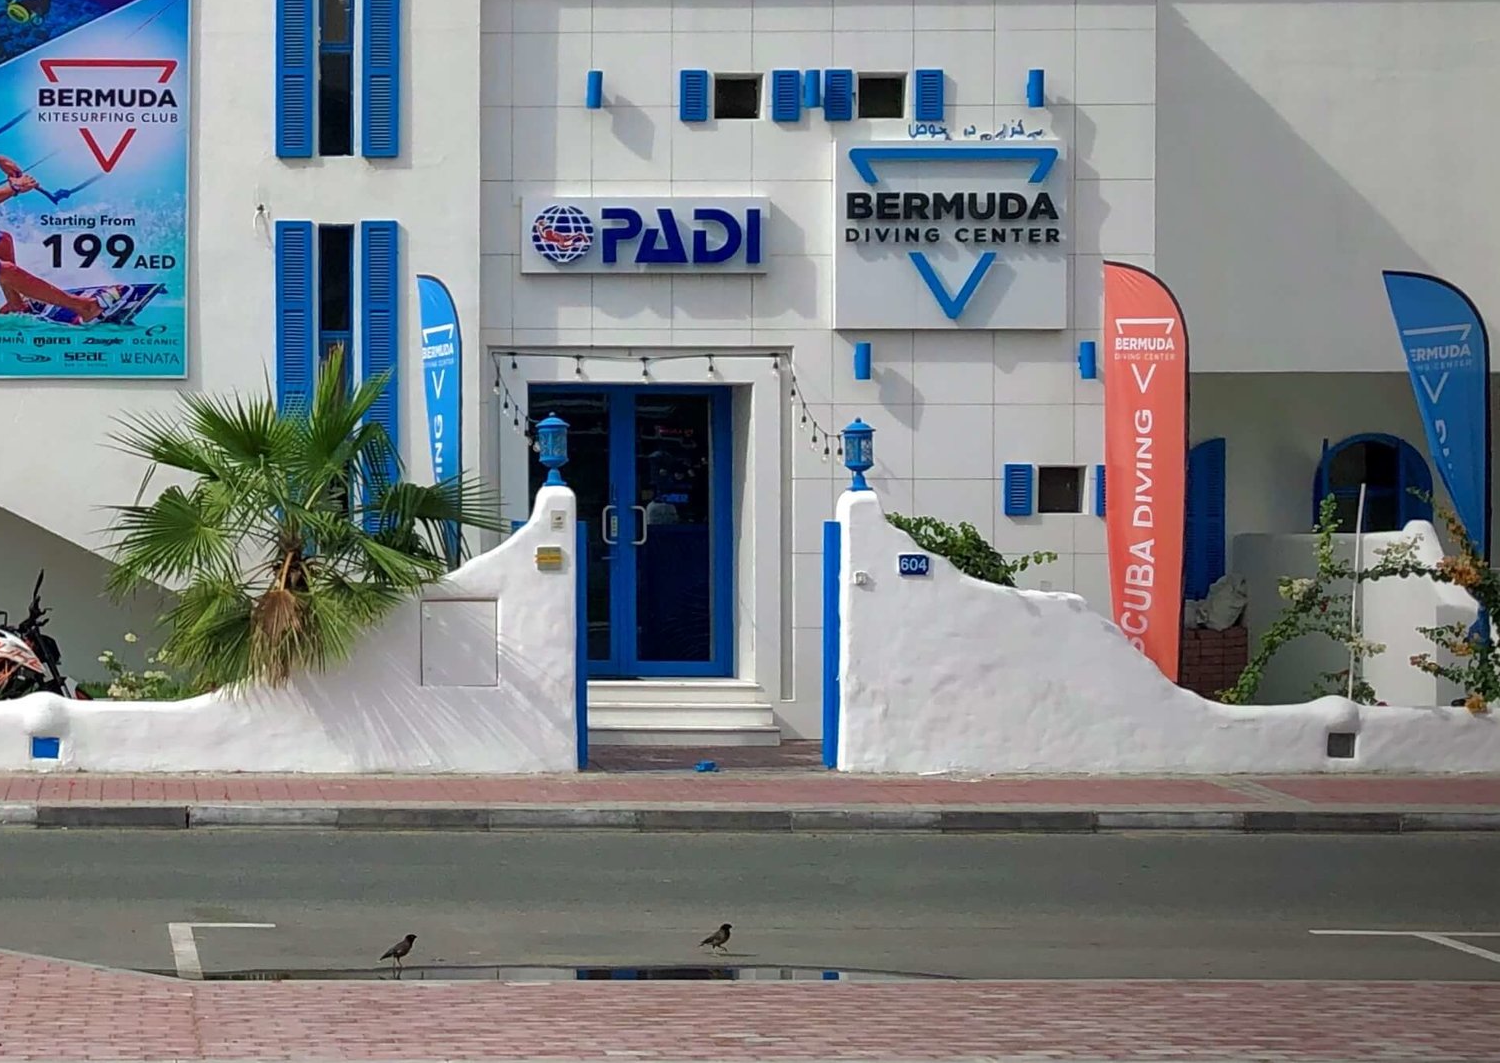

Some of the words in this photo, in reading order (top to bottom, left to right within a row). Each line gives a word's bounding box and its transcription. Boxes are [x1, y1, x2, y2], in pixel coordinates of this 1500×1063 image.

[38, 88, 178, 108] BERMUDA
[38, 112, 135, 123] KITESURFING
[141, 112, 178, 123] CLUB
[846, 191, 1059, 220] BERMUDA
[40, 215, 96, 229] Starting
[100, 215, 136, 227] From
[602, 207, 761, 264] PADI
[846, 228, 940, 243] DIVING
[955, 227, 1060, 243] CENTER
[42, 233, 134, 269] 199
[134, 254, 175, 270] AED
[1115, 337, 1174, 352] BERMUDA
[1409, 343, 1471, 362] ERMUDA
[1144, 353, 1175, 361] CENTER
[1133, 409, 1154, 528] DIVING
[901, 558, 927, 571] 604
